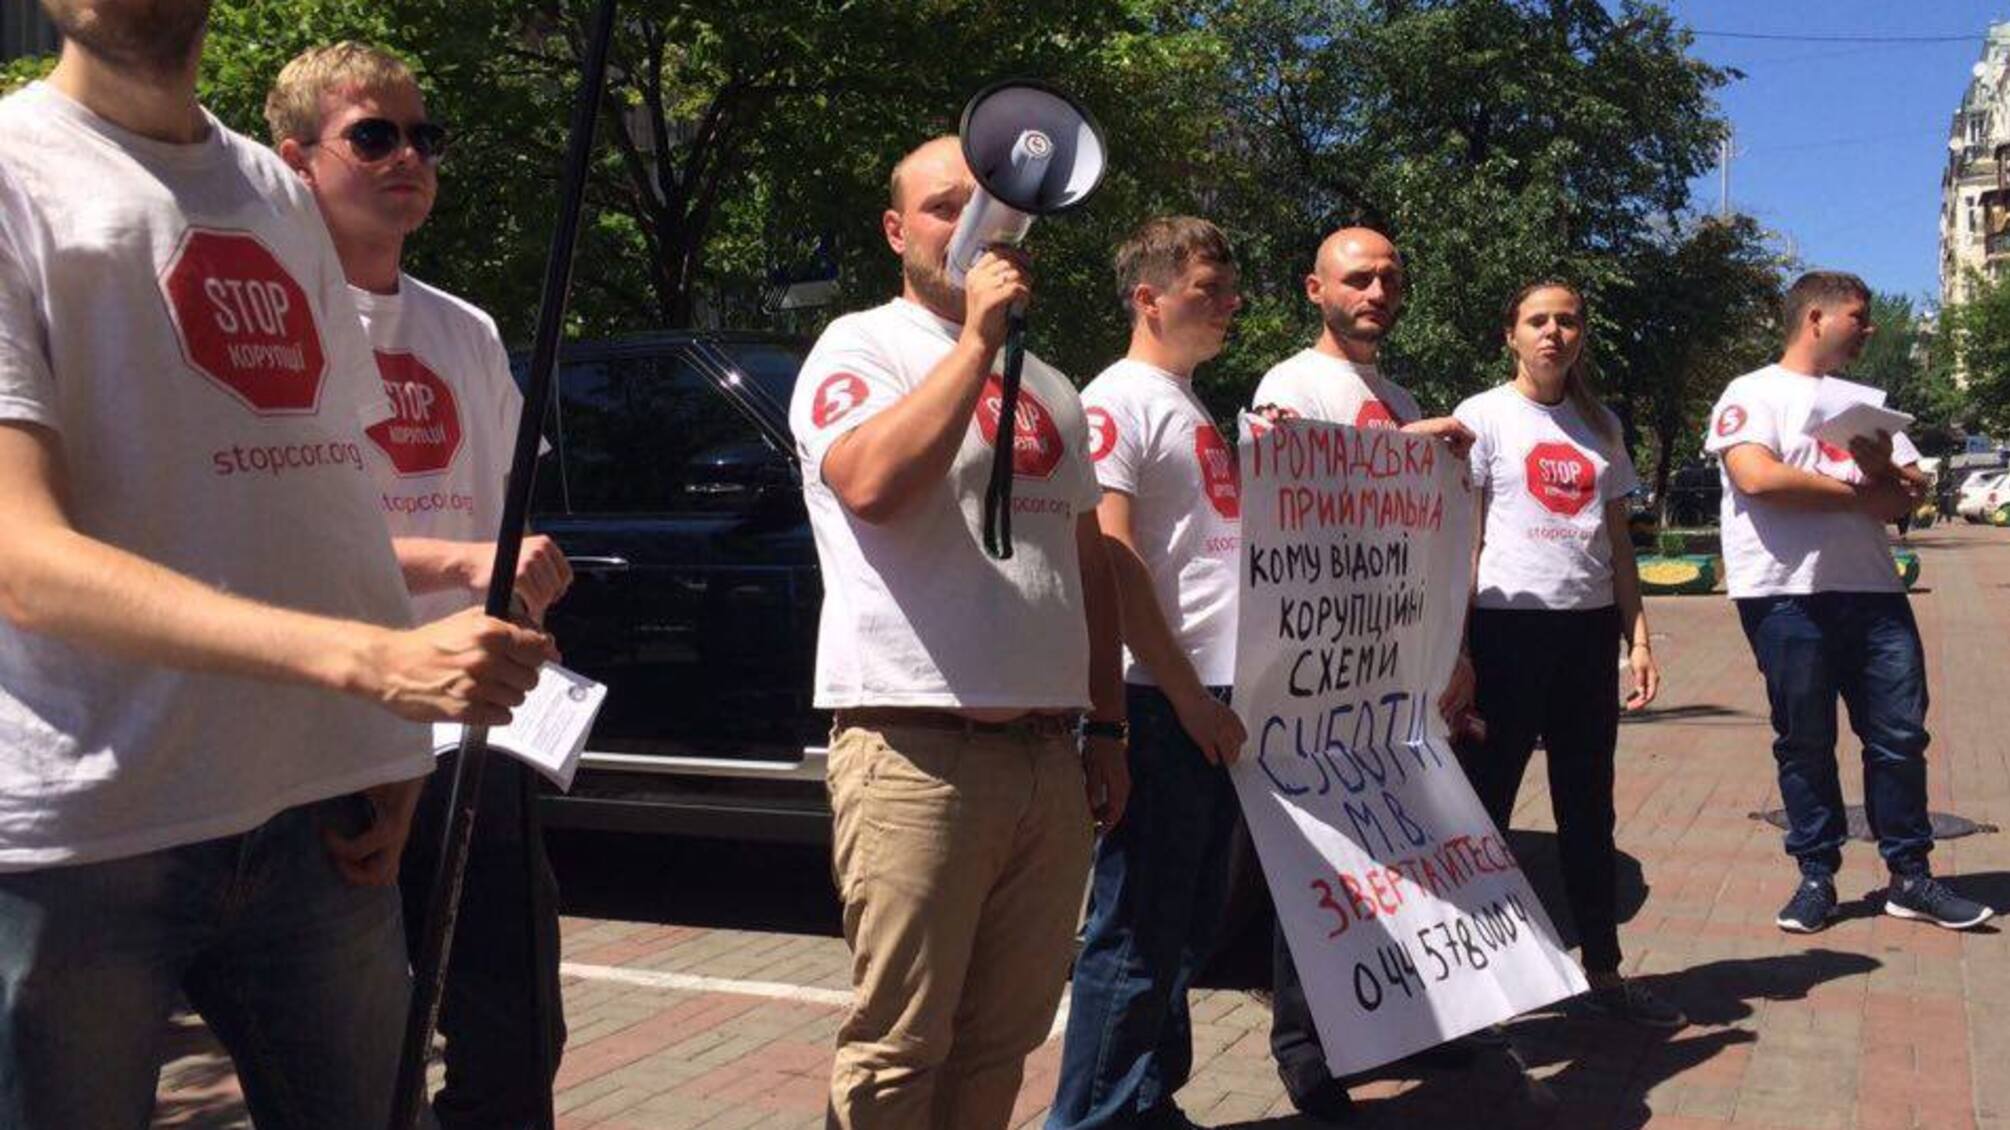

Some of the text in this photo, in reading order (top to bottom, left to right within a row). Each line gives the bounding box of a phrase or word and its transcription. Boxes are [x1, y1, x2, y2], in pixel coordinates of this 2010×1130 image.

[204, 277, 290, 337] STOP
[213, 443, 364, 476] stopcor.org
[1538, 458, 1581, 483] STOP
[1279, 486, 1443, 531] ПРИЙМАЛЬНА
[1250, 531, 1409, 588] КОМУ ВІДОМІ
[1279, 579, 1426, 643] КОРУПЦІЙНІ
[1289, 641, 1399, 697] СХЕМИ
[1258, 691, 1442, 795] СУБОТИ
[1353, 942, 1426, 1011] 044
